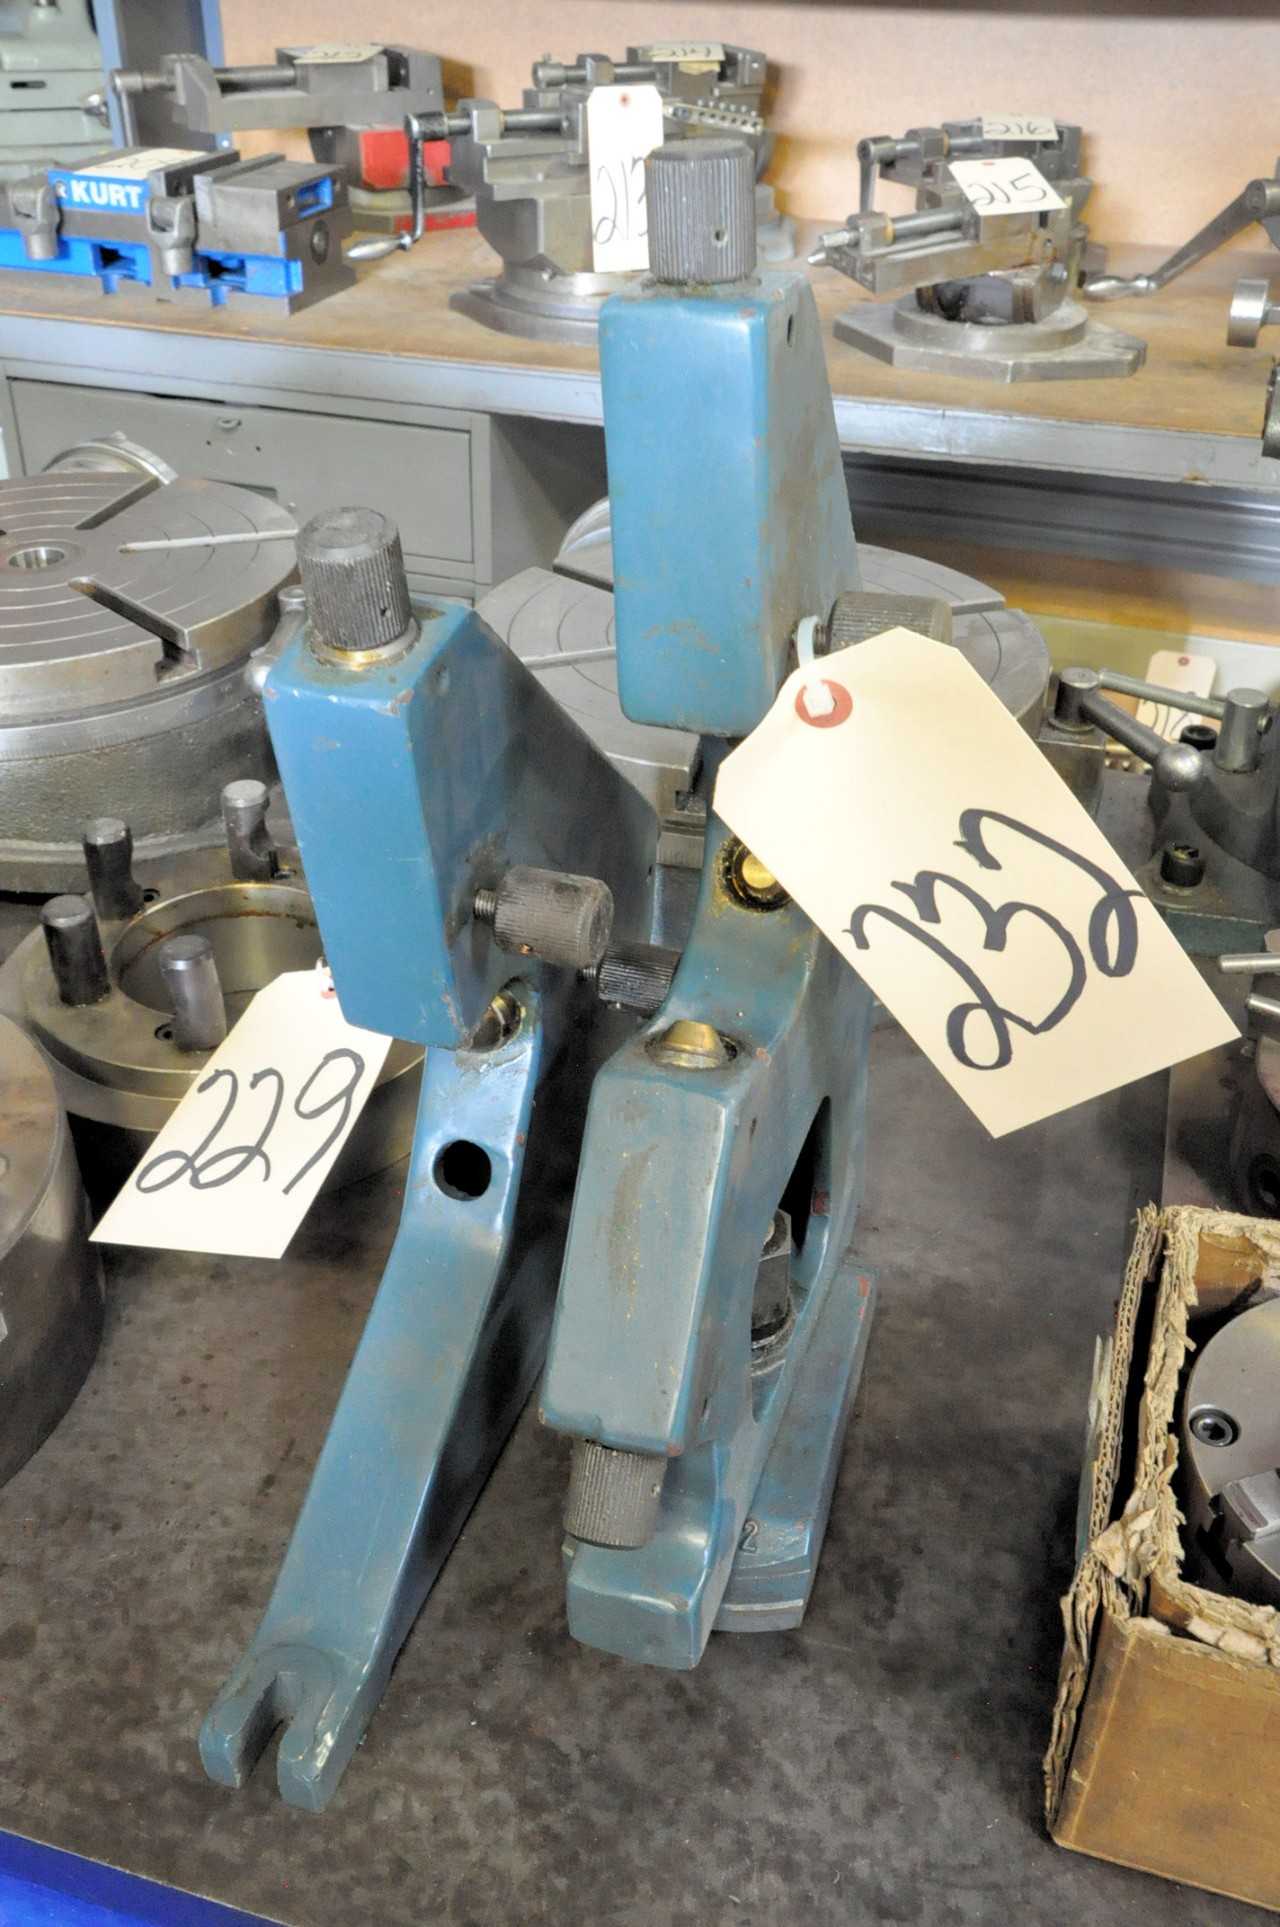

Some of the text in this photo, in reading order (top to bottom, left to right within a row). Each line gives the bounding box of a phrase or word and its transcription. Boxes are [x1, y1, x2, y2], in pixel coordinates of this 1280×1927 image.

[69, 179, 143, 208] KURT
[967, 172, 1048, 206] 215
[842, 808, 1147, 1071] 232
[136, 1047, 366, 1195] 229
[740, 1520, 759, 1554] 2
